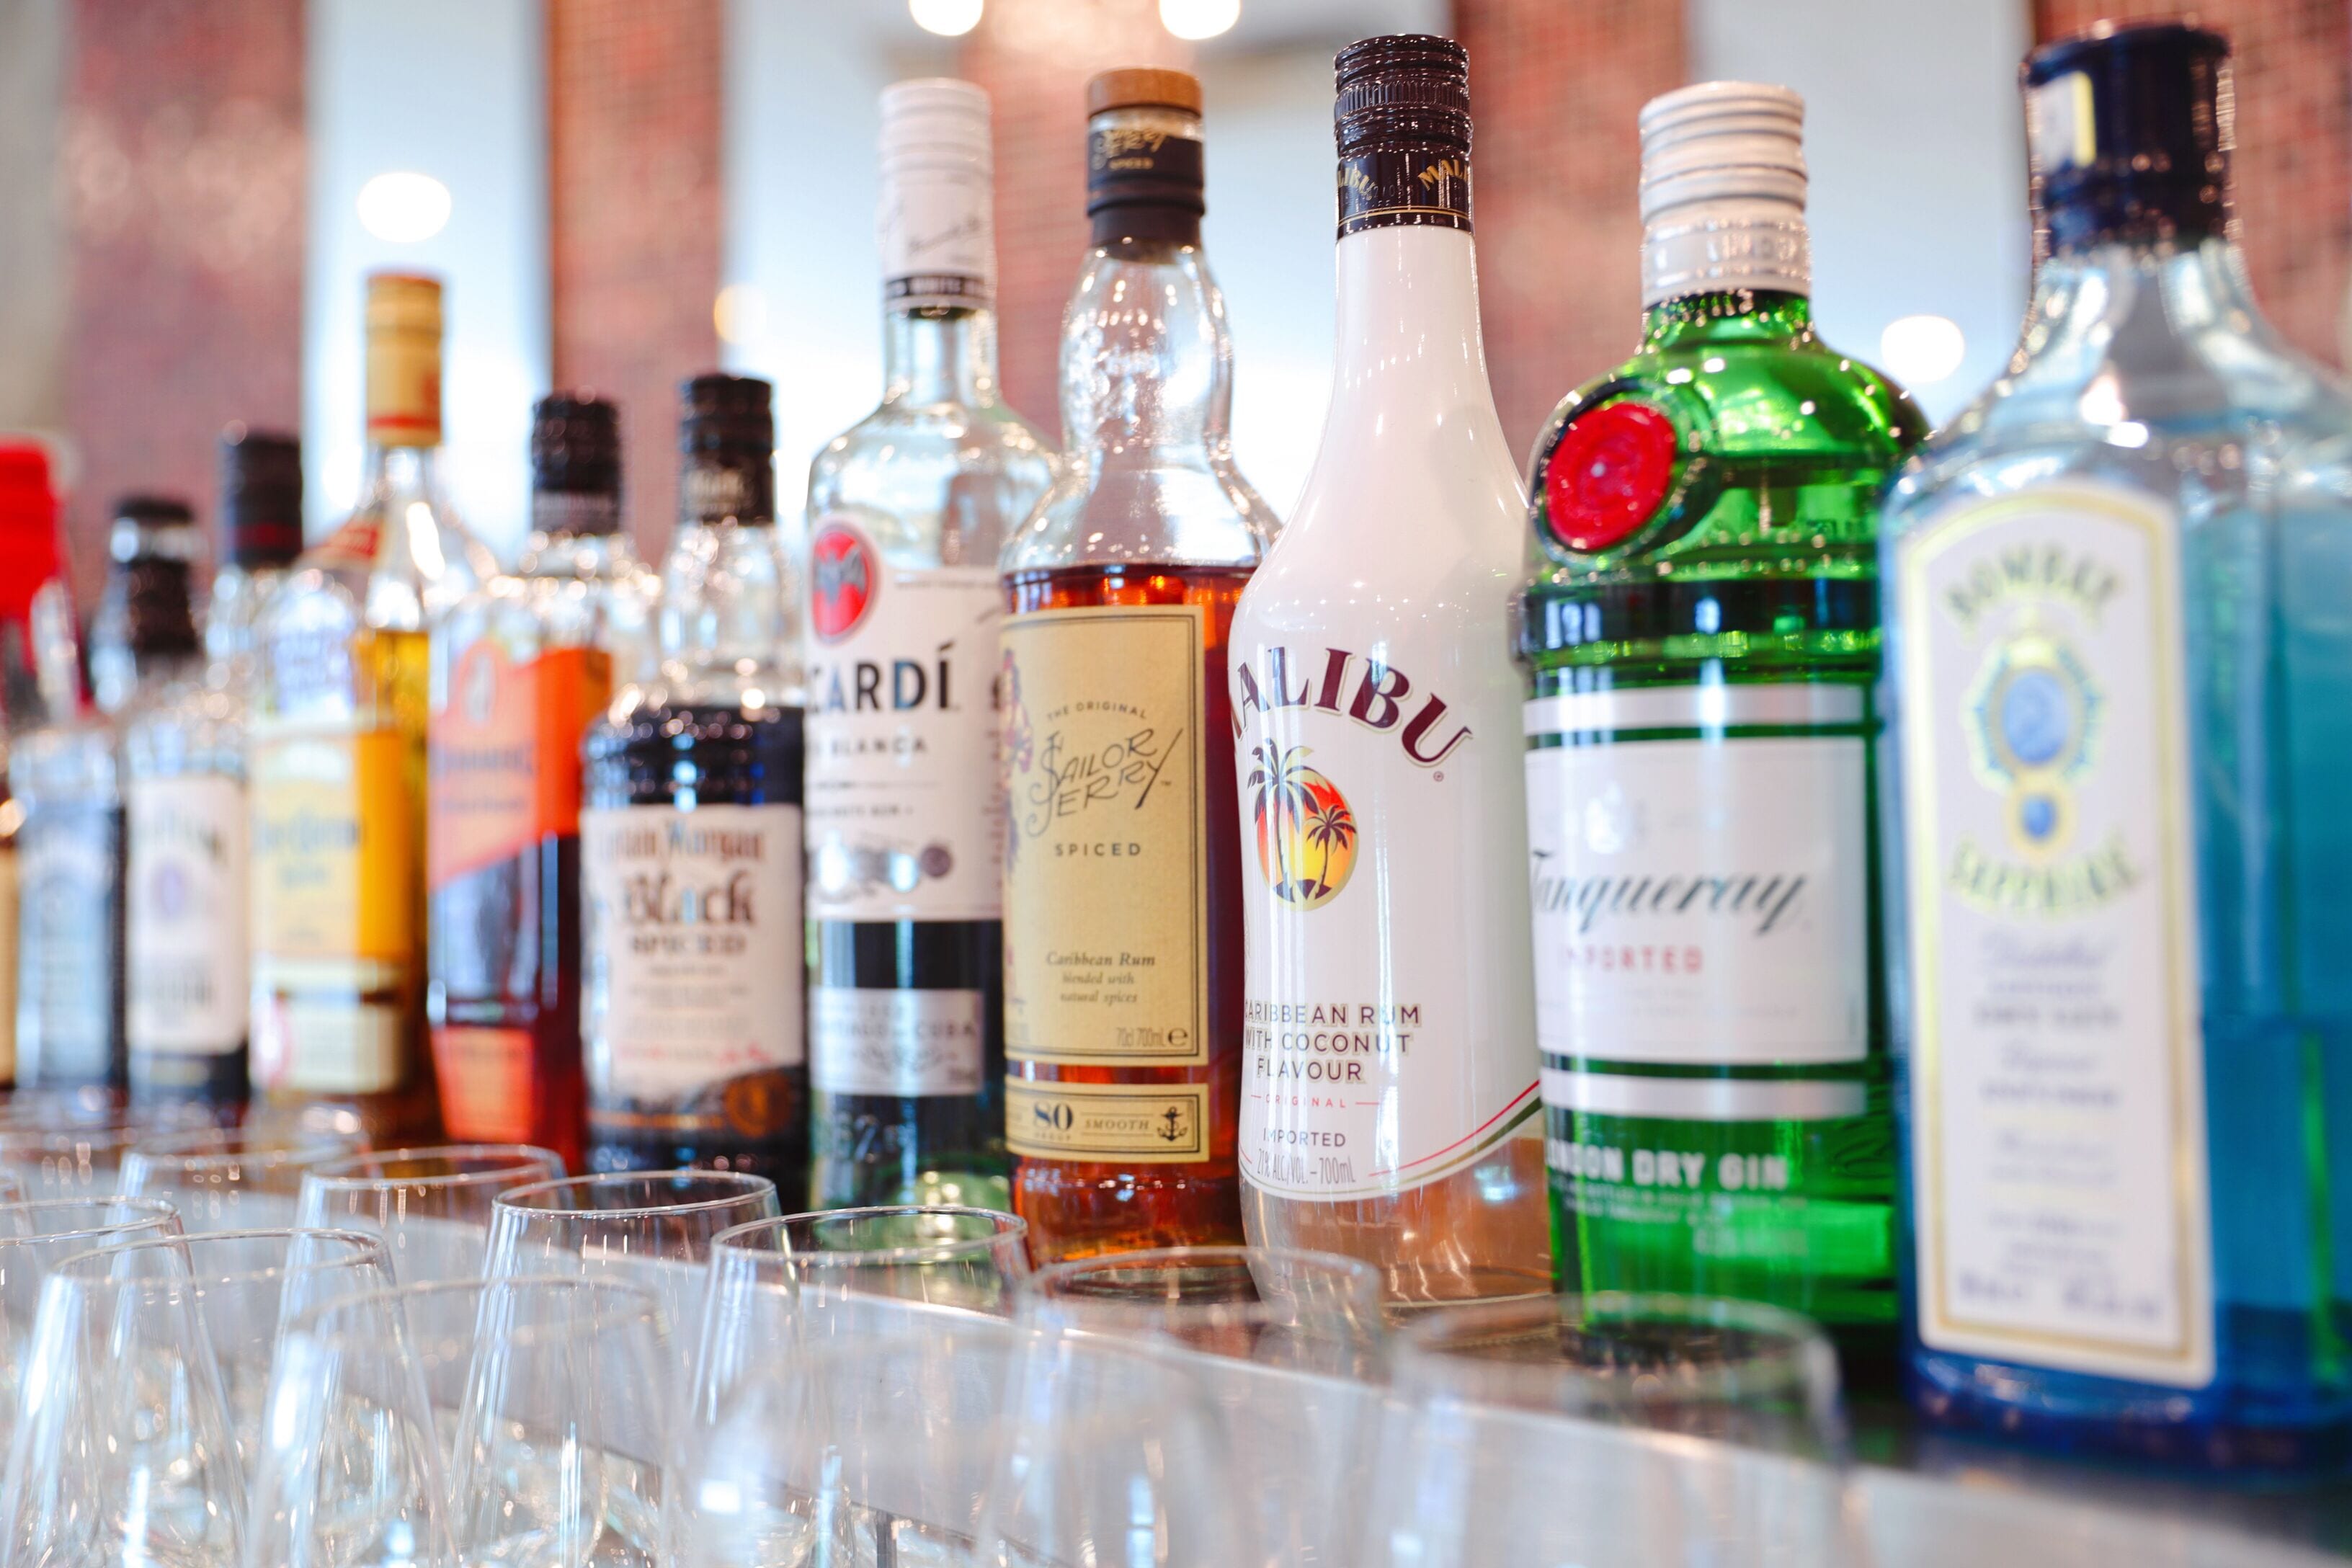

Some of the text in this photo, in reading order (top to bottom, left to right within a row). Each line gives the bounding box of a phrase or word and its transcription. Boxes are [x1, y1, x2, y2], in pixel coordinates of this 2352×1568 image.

[1047, 701, 1147, 721] THE ORIGINAL
[1056, 842, 1141, 857] SPICED
[1046, 951, 1156, 966] Caribbean Rum
[1108, 974, 1135, 985] with
[1360, 1005, 1420, 1025] RUM
[1245, 1026, 1410, 1054] WITH COCONUT
[1257, 1058, 1362, 1081] FLAVOUR
[1265, 1093, 1346, 1108] ORIGINAL
[1033, 1101, 1074, 1132] 80
[1084, 1119, 1149, 1131] SMOOTH
[1262, 1128, 1346, 1147] IMPORTED
[1632, 1149, 1705, 1188] DRY
[1719, 1153, 1788, 1190] GIN
